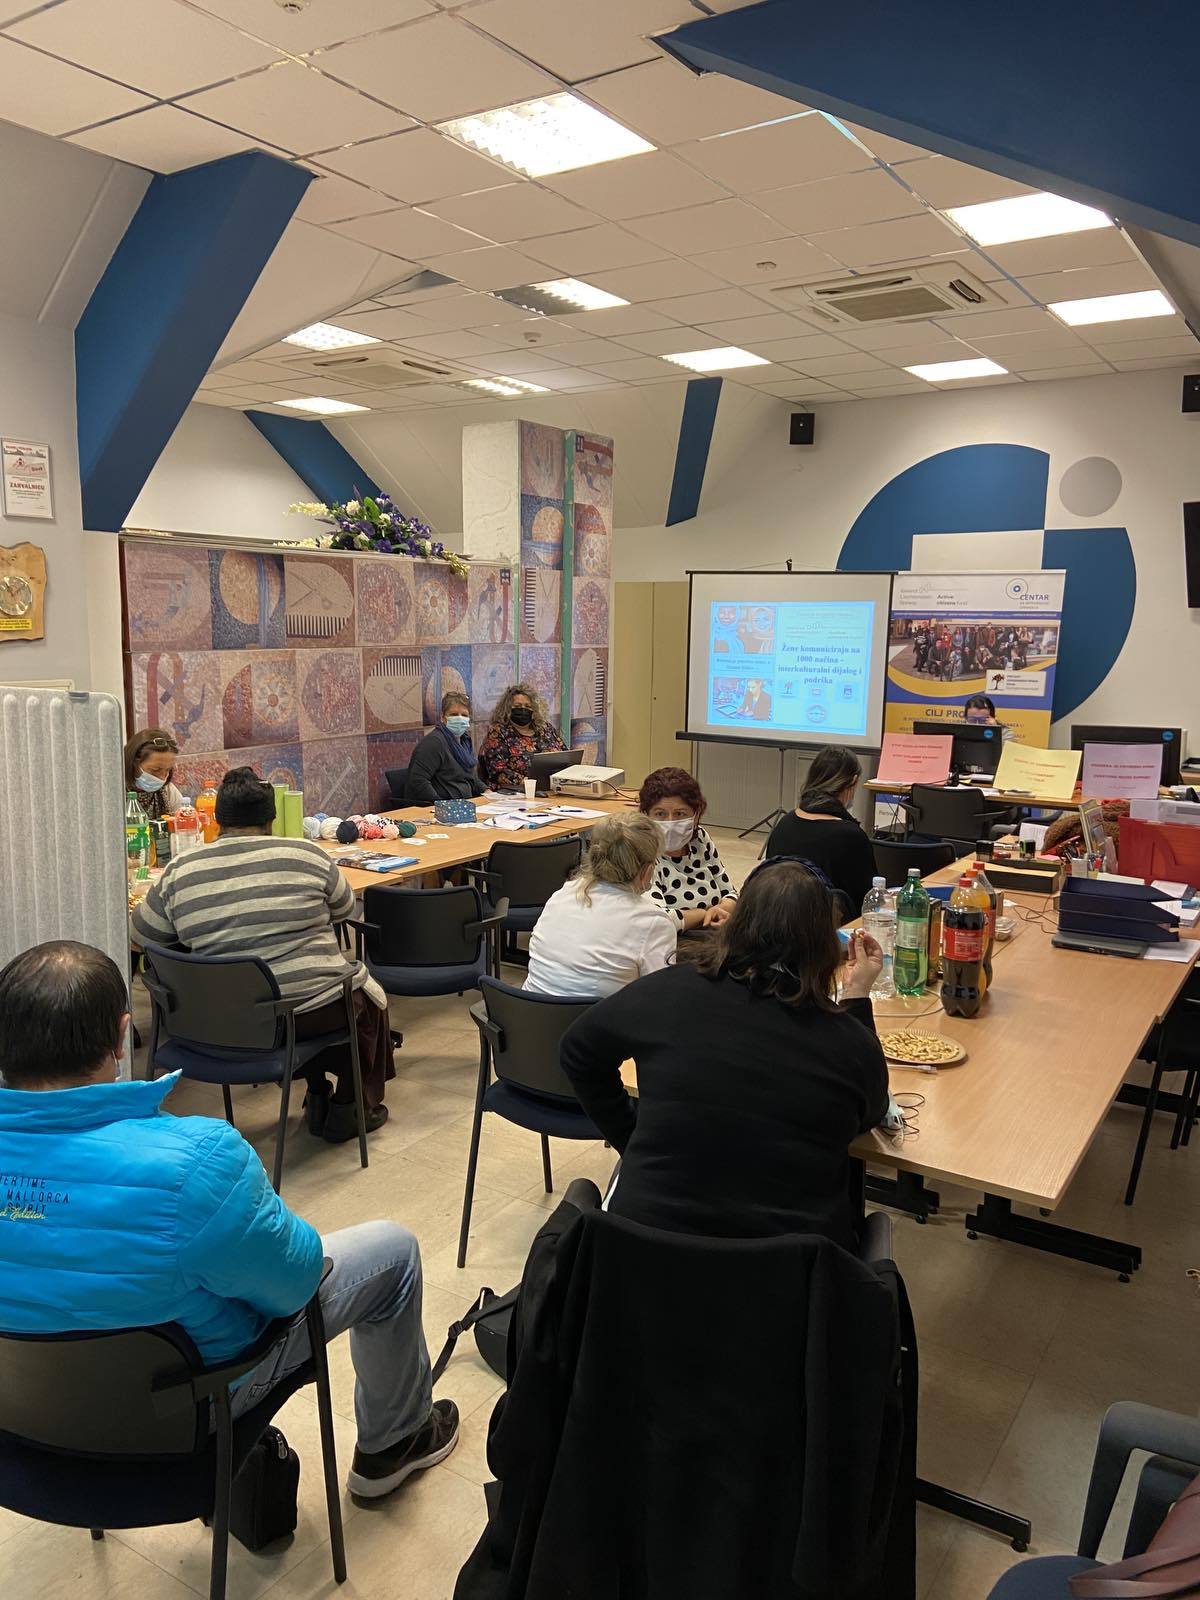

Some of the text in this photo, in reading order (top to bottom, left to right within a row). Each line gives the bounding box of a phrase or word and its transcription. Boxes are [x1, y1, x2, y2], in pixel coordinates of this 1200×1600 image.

[800, 645, 849, 655] komuniciraju
[814, 655, 838, 663] načina
[832, 666, 857, 676] dijalog
[925, 708, 944, 717] CILJ
[7, 1189, 69, 1203] MALLORCA
